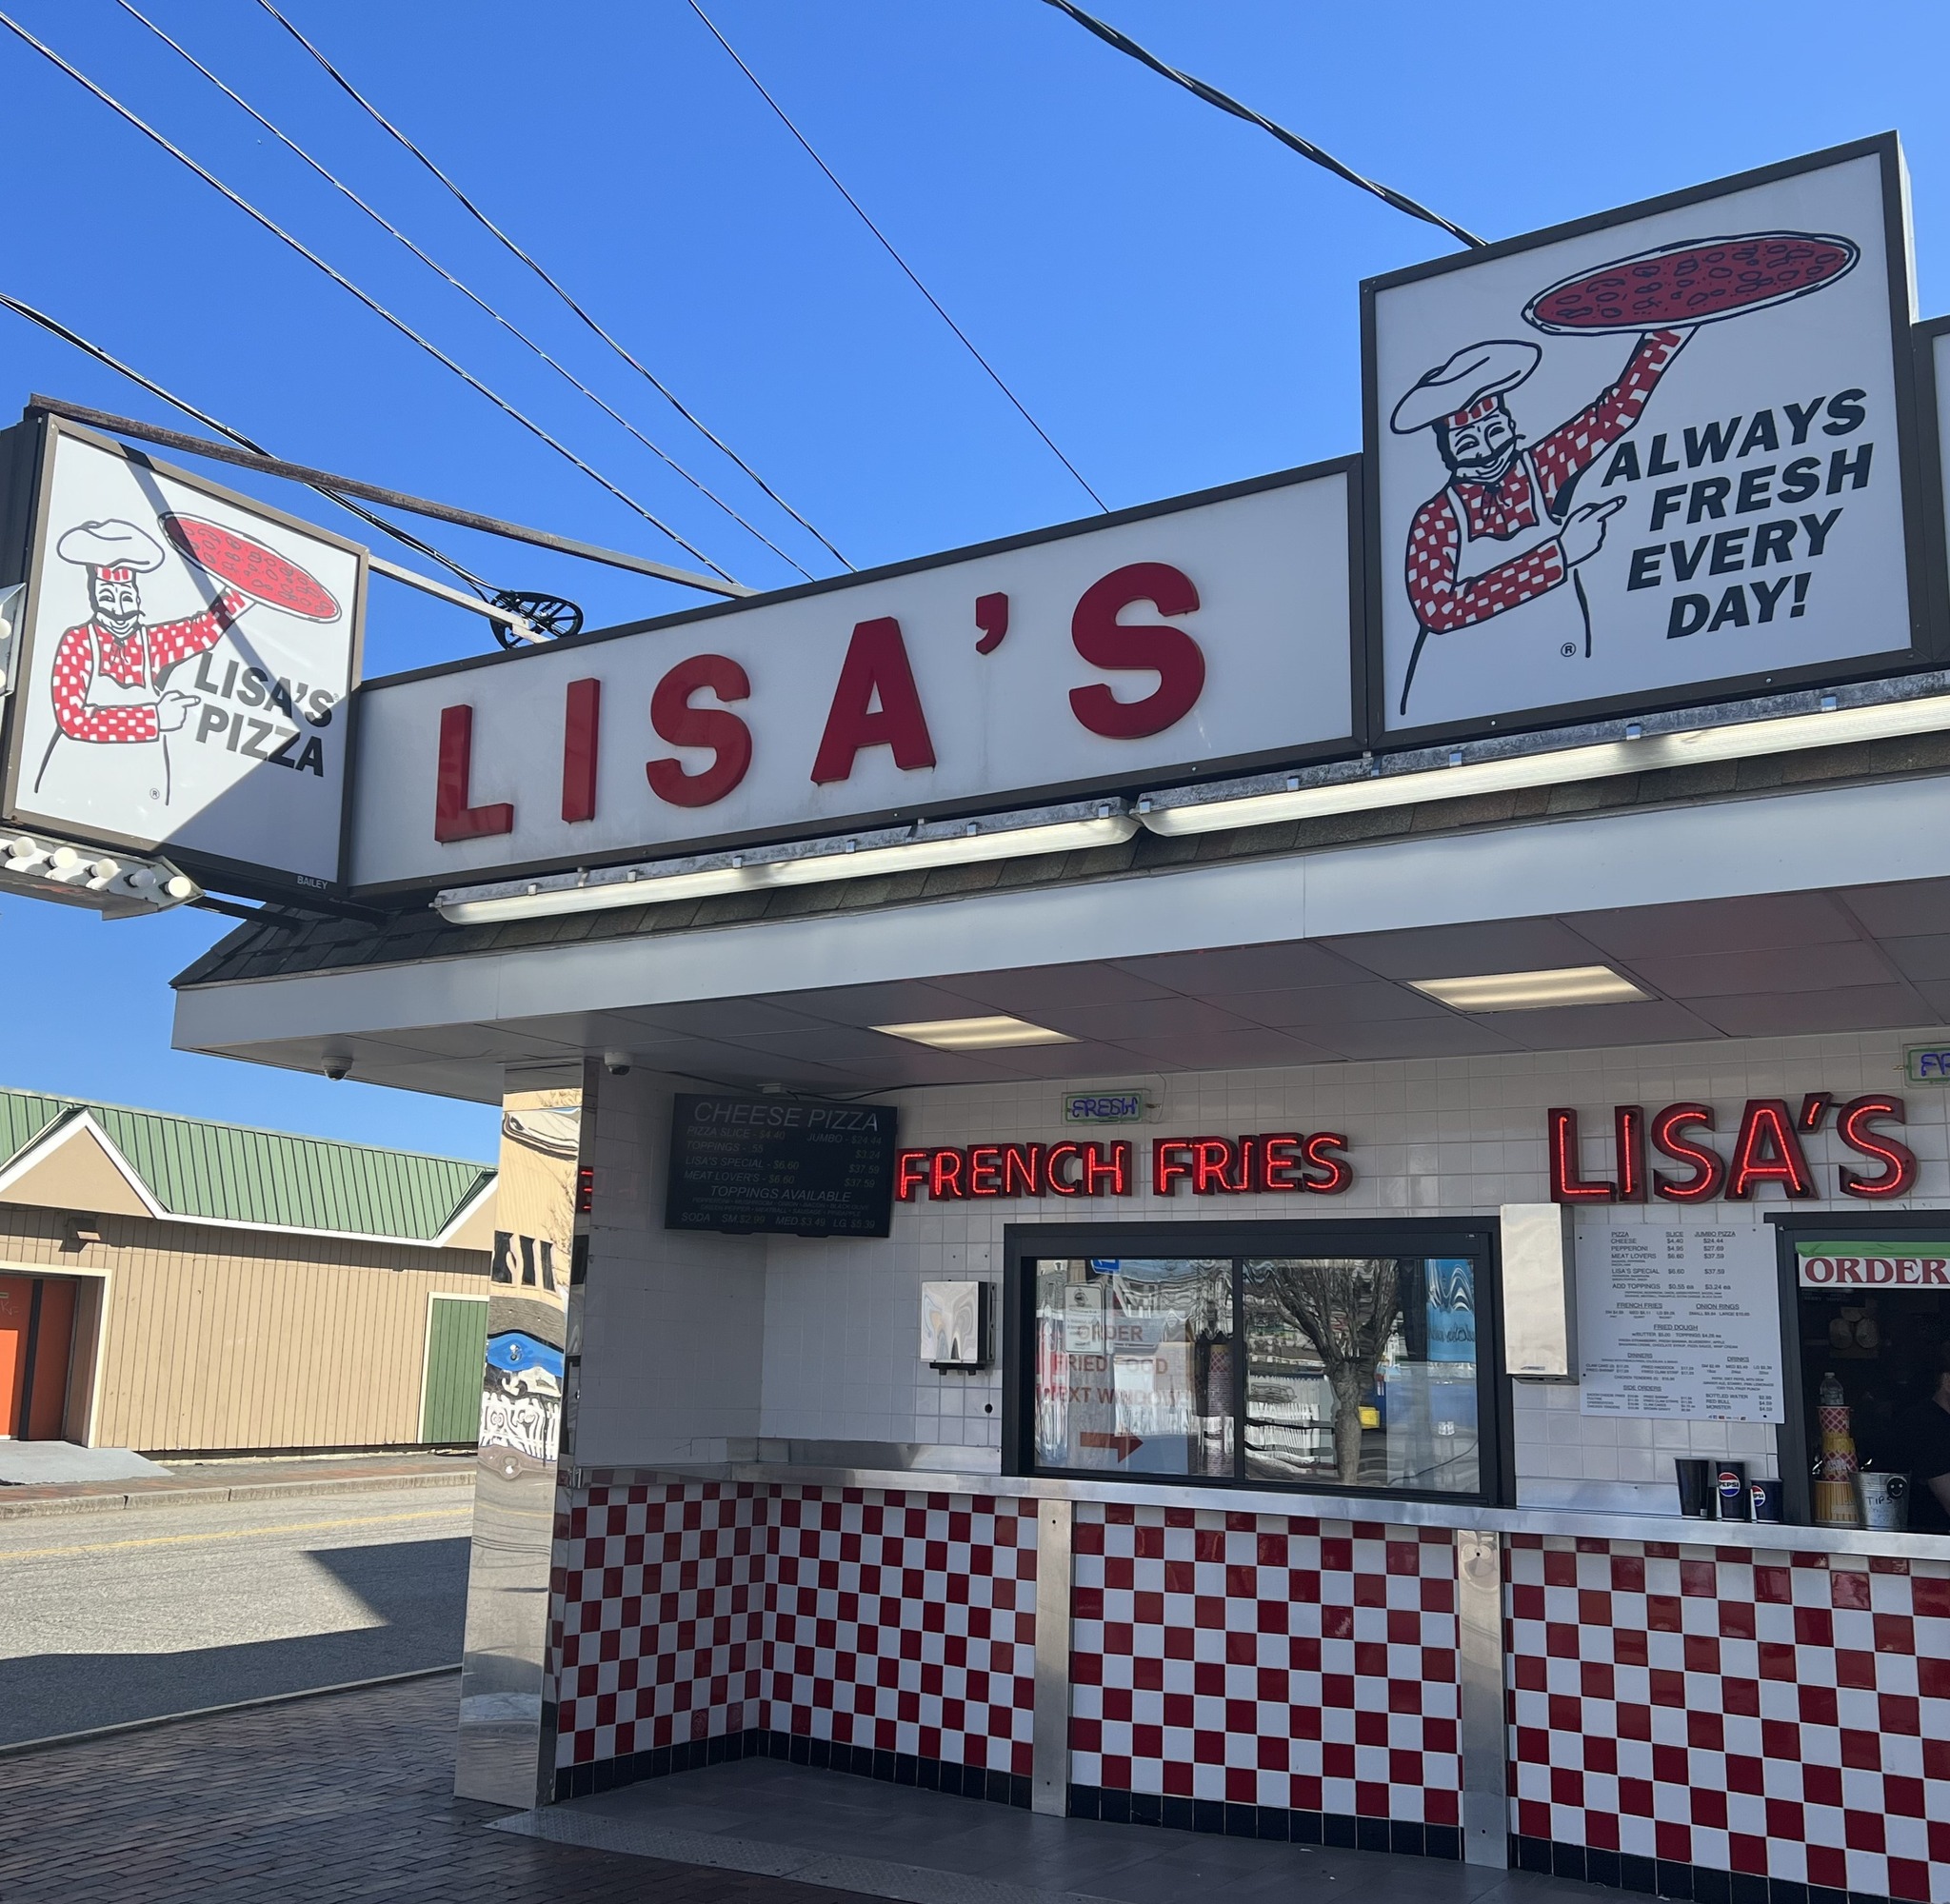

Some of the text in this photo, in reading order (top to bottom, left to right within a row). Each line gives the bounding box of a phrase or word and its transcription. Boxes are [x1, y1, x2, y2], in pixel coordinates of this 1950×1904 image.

[1601, 388, 1868, 487] ALWAYS
[1649, 442, 1874, 533] FRESH
[1626, 506, 1844, 592] EVERY
[1666, 572, 1813, 640] DAY!
[194, 650, 334, 728] LISA'S
[434, 561, 1206, 844] LISA'S
[195, 703, 325, 778] PIZZA
[297, 875, 328, 890] BAILEY
[694, 1101, 879, 1132] CHEESE PIZZA
[1072, 1097, 1138, 1118] FRESH
[686, 1125, 717, 1137] PIZZA
[720, 1127, 751, 1139] SLICE
[806, 1133, 843, 1143] JUMBO
[686, 1140, 741, 1152] TOPPINGS
[1547, 1091, 1920, 1204] LISA'S
[684, 1169, 713, 1180] MEAT
[720, 1158, 764, 1168] SPECIAL
[894, 1131, 1353, 1202] FRENCH FRIES
[710, 1185, 852, 1202] TOPPINGS AVAILABLE
[681, 1211, 710, 1222] SODA
[1805, 1257, 1950, 1284] ORDER
[1865, 1496, 1893, 1506] TIPS
